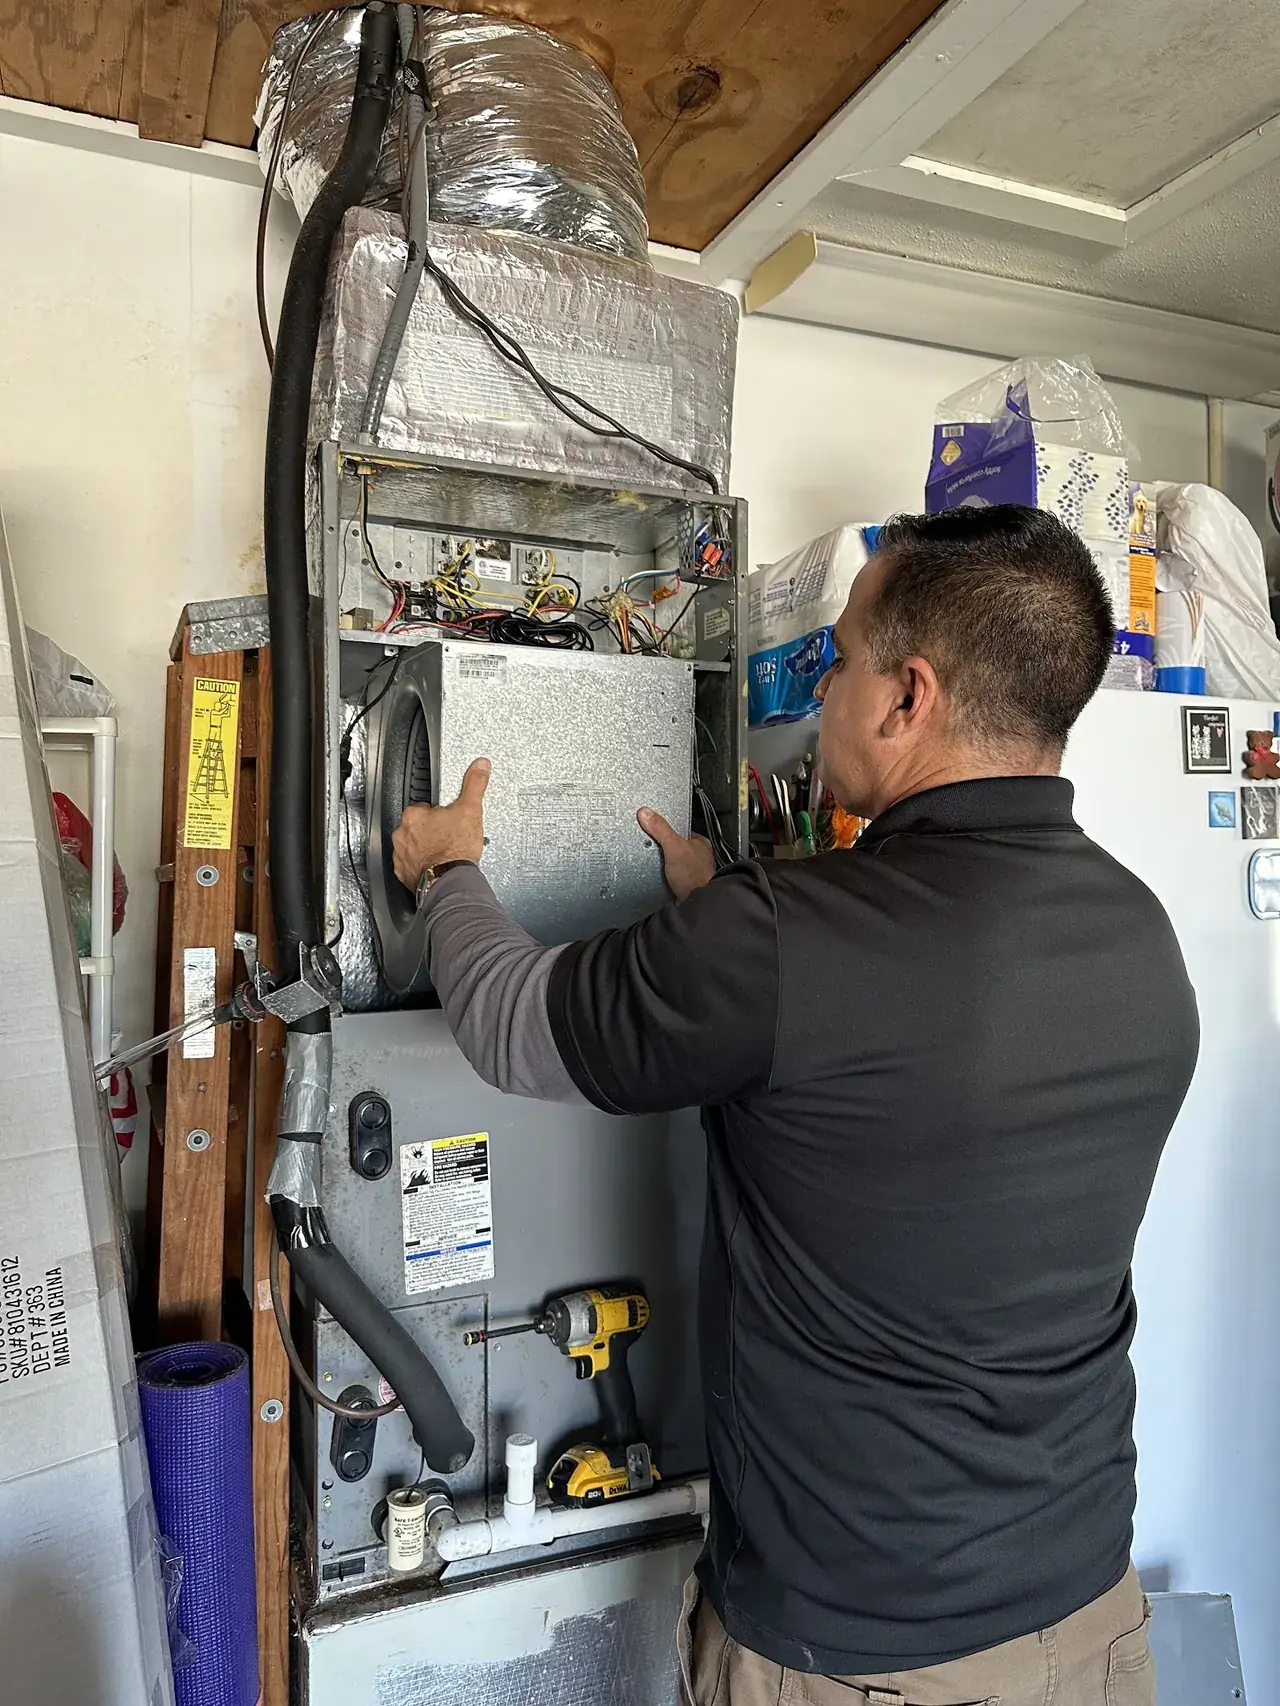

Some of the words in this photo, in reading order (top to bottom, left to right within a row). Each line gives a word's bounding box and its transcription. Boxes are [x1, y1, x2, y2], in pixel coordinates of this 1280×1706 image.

[197, 680, 236, 694] CAUTION
[45, 1266, 64, 1309] CHINA
[49, 1310, 66, 1327] IN
[51, 1327, 70, 1367] MADE
